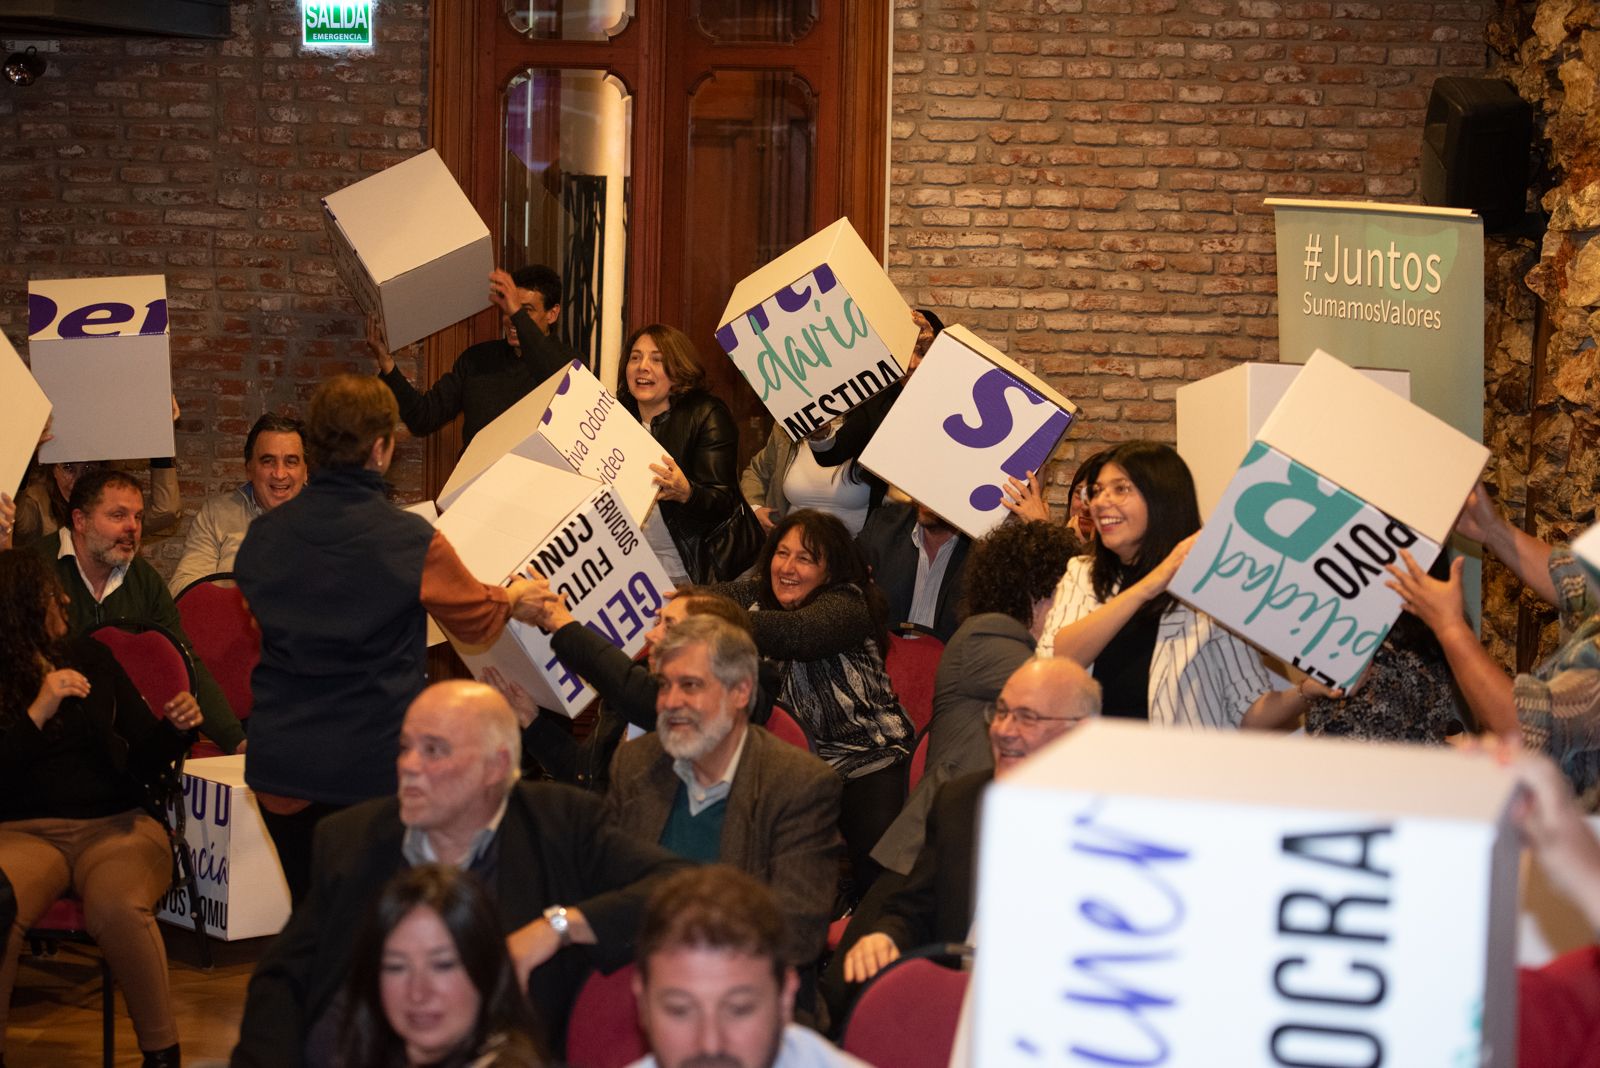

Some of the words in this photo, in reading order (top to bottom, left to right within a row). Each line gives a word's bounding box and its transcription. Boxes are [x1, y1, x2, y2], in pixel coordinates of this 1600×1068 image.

[306, 0, 367, 28] SALIDA
[1303, 233, 1442, 294] #Juntos
[1303, 291, 1442, 330] SumamosValores
[783, 355, 906, 443] NESTIDA
[545, 571, 663, 703] GENE
[1269, 823, 1393, 1068] OCRA
